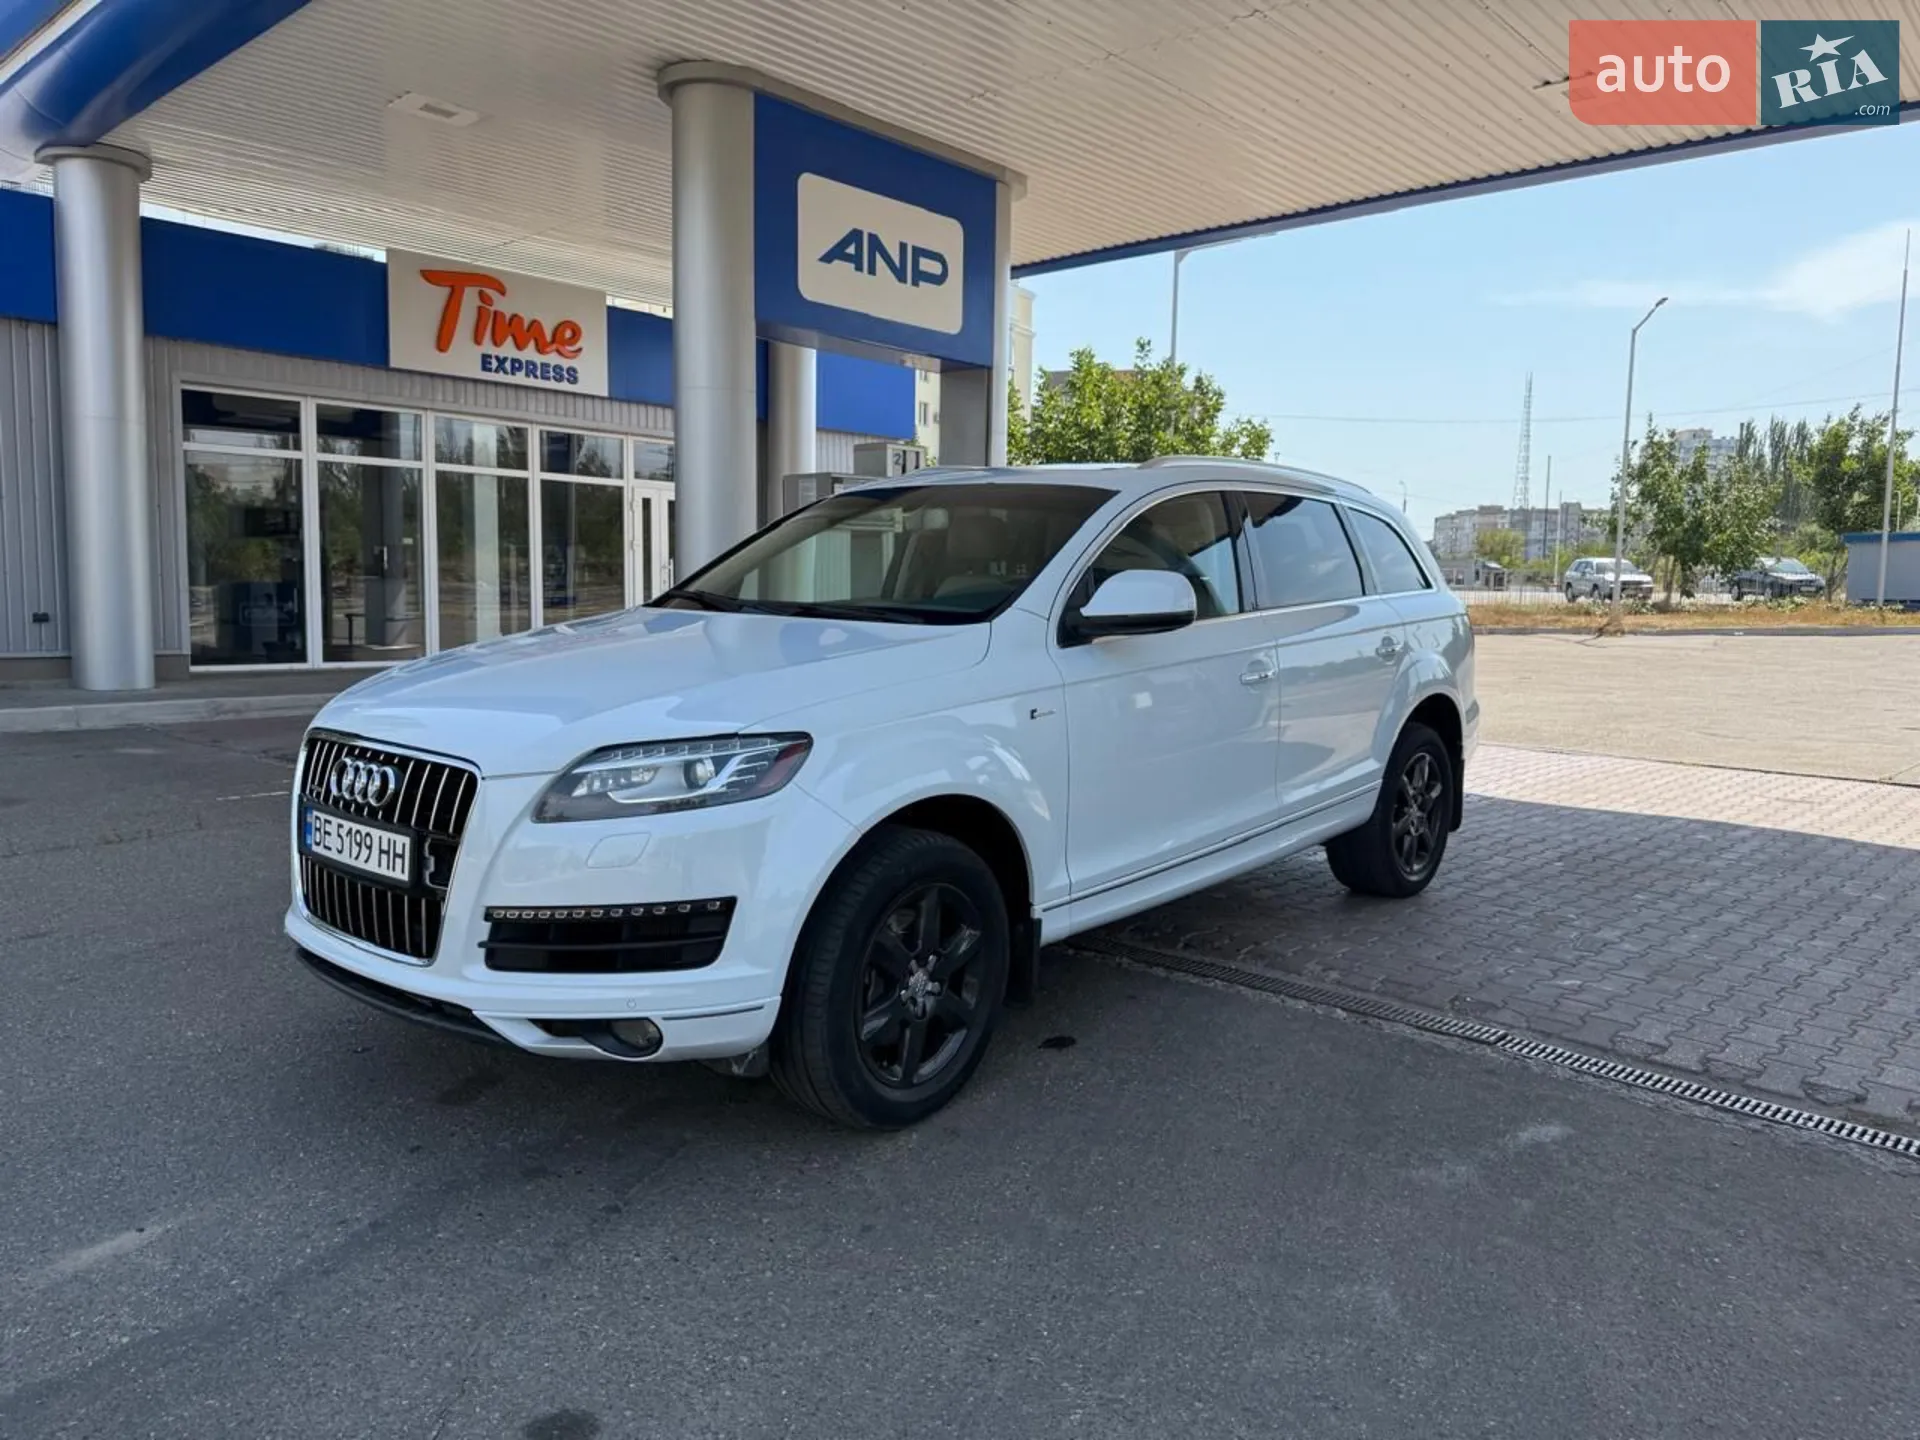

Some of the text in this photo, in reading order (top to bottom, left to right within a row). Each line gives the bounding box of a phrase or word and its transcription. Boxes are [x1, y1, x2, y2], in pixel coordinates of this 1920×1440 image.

[818, 228, 949, 288] ANP
[420, 269, 583, 359] Time
[481, 353, 579, 385] EXPRESS
[314, 815, 406, 874] BE 5199 HH
